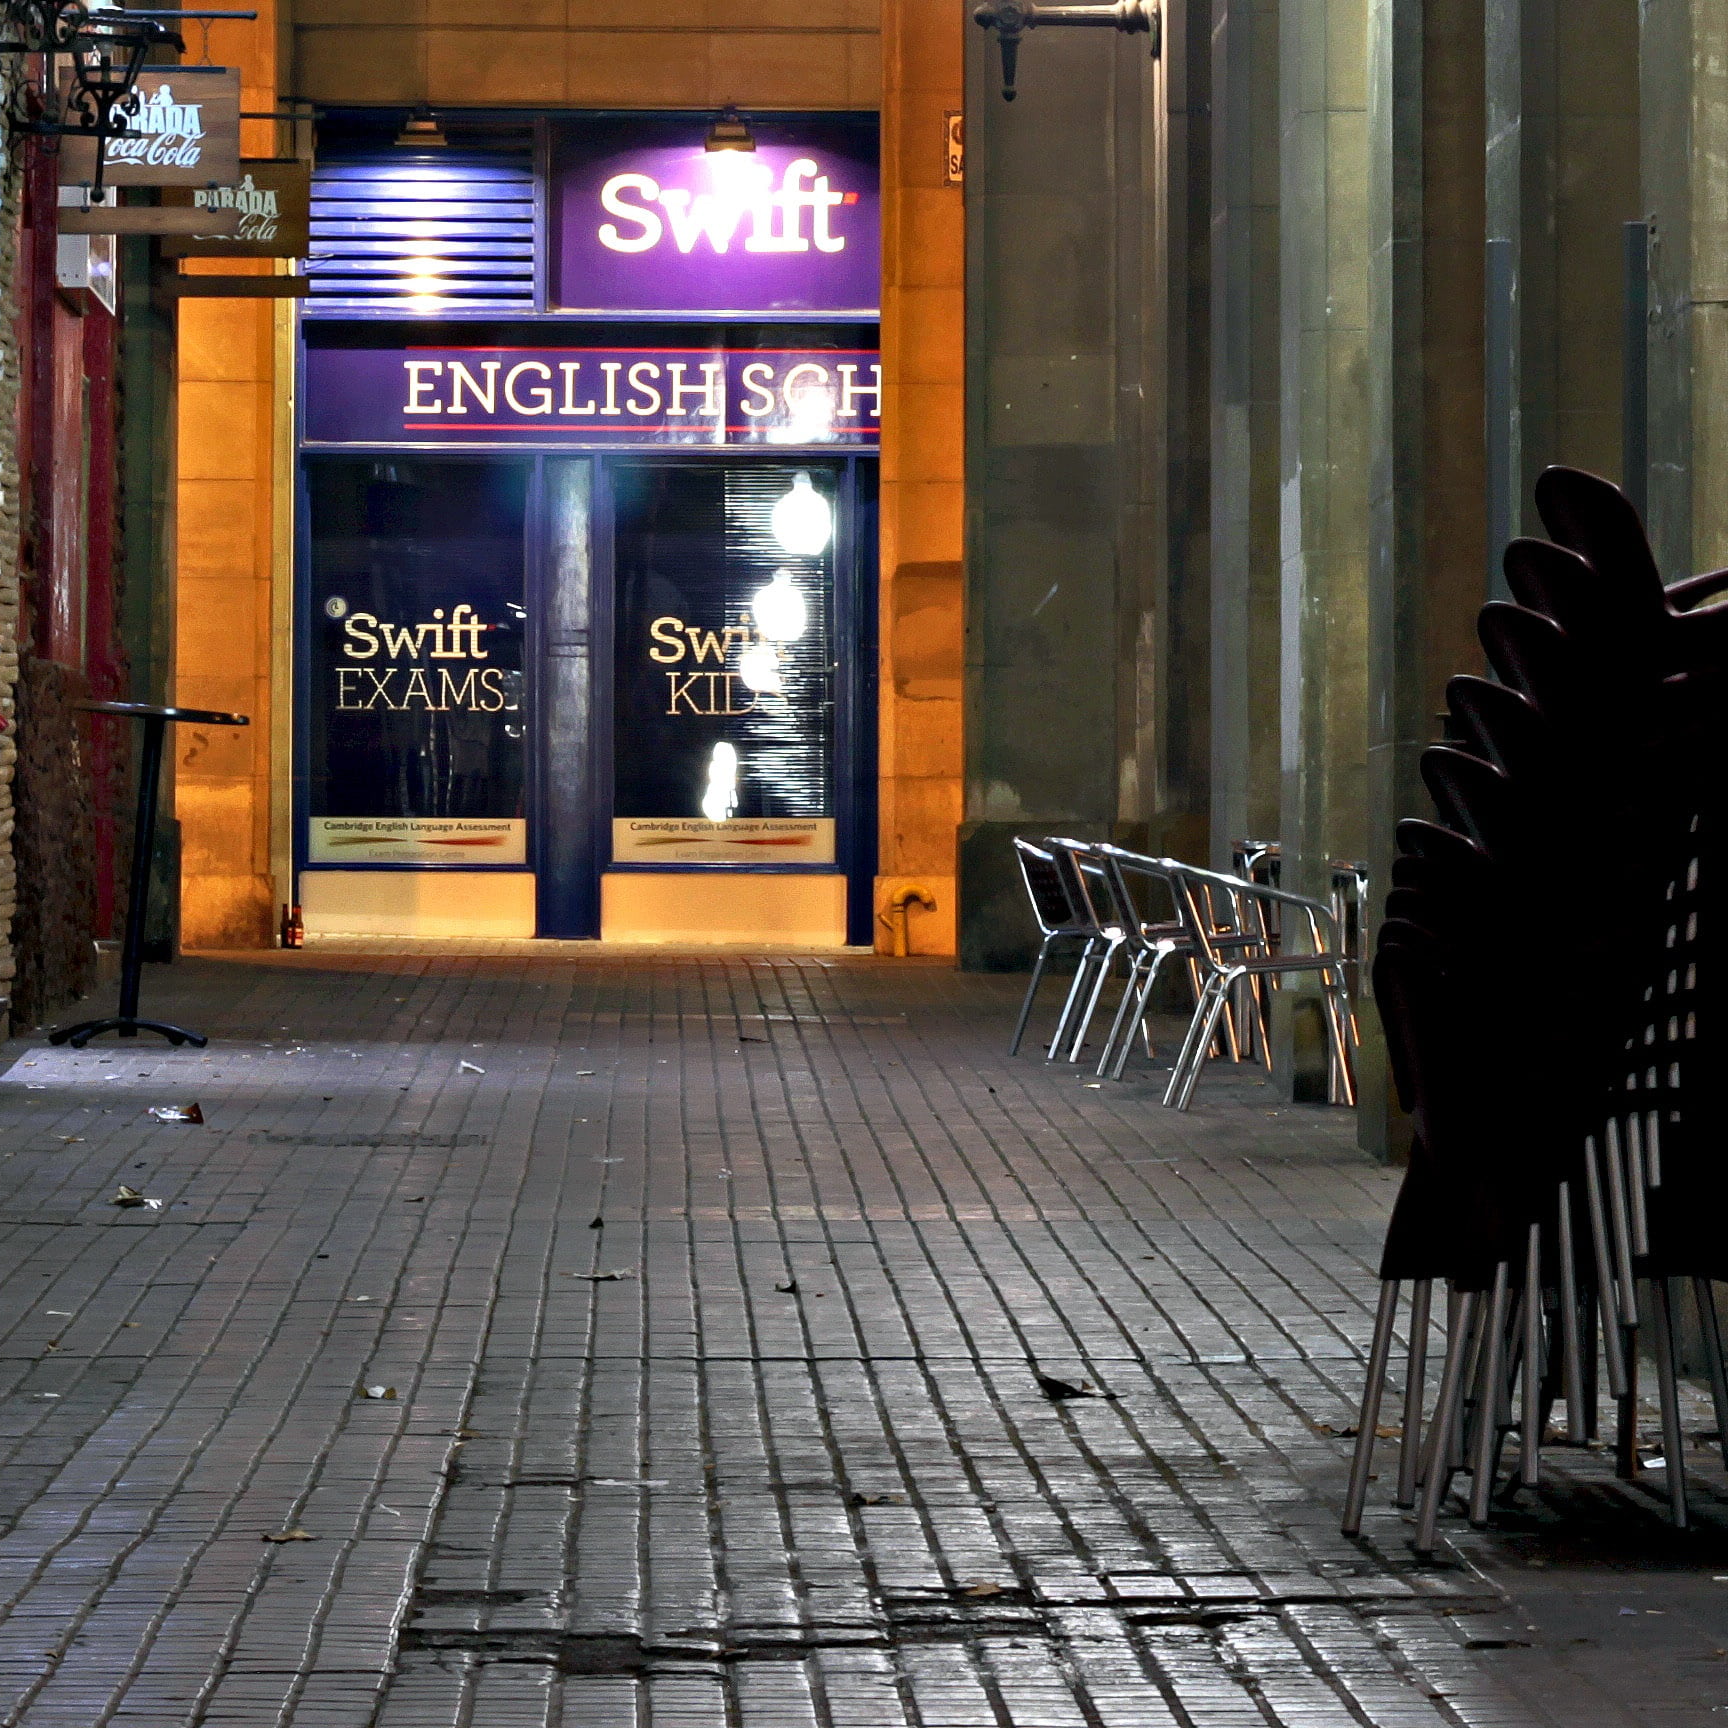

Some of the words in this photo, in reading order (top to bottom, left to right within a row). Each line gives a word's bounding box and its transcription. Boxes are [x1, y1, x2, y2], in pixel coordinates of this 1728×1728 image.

[109, 104, 202, 135] RADA
[104, 136, 150, 165] oca
[194, 190, 277, 215] PARADA
[598, 158, 846, 253] Swift
[403, 360, 722, 417] ENGLISH
[343, 604, 489, 659] Swift
[649, 608, 797, 664] Swi
[335, 668, 504, 712] EXAMS
[323, 821, 373, 832] Cambridge
[375, 821, 408, 832] English
[410, 822, 454, 832] Language
[456, 822, 512, 831] Assessment
[630, 821, 679, 832] Cambridge
[681, 821, 714, 832] English
[717, 822, 759, 832] Language
[762, 822, 818, 831] Assessment
